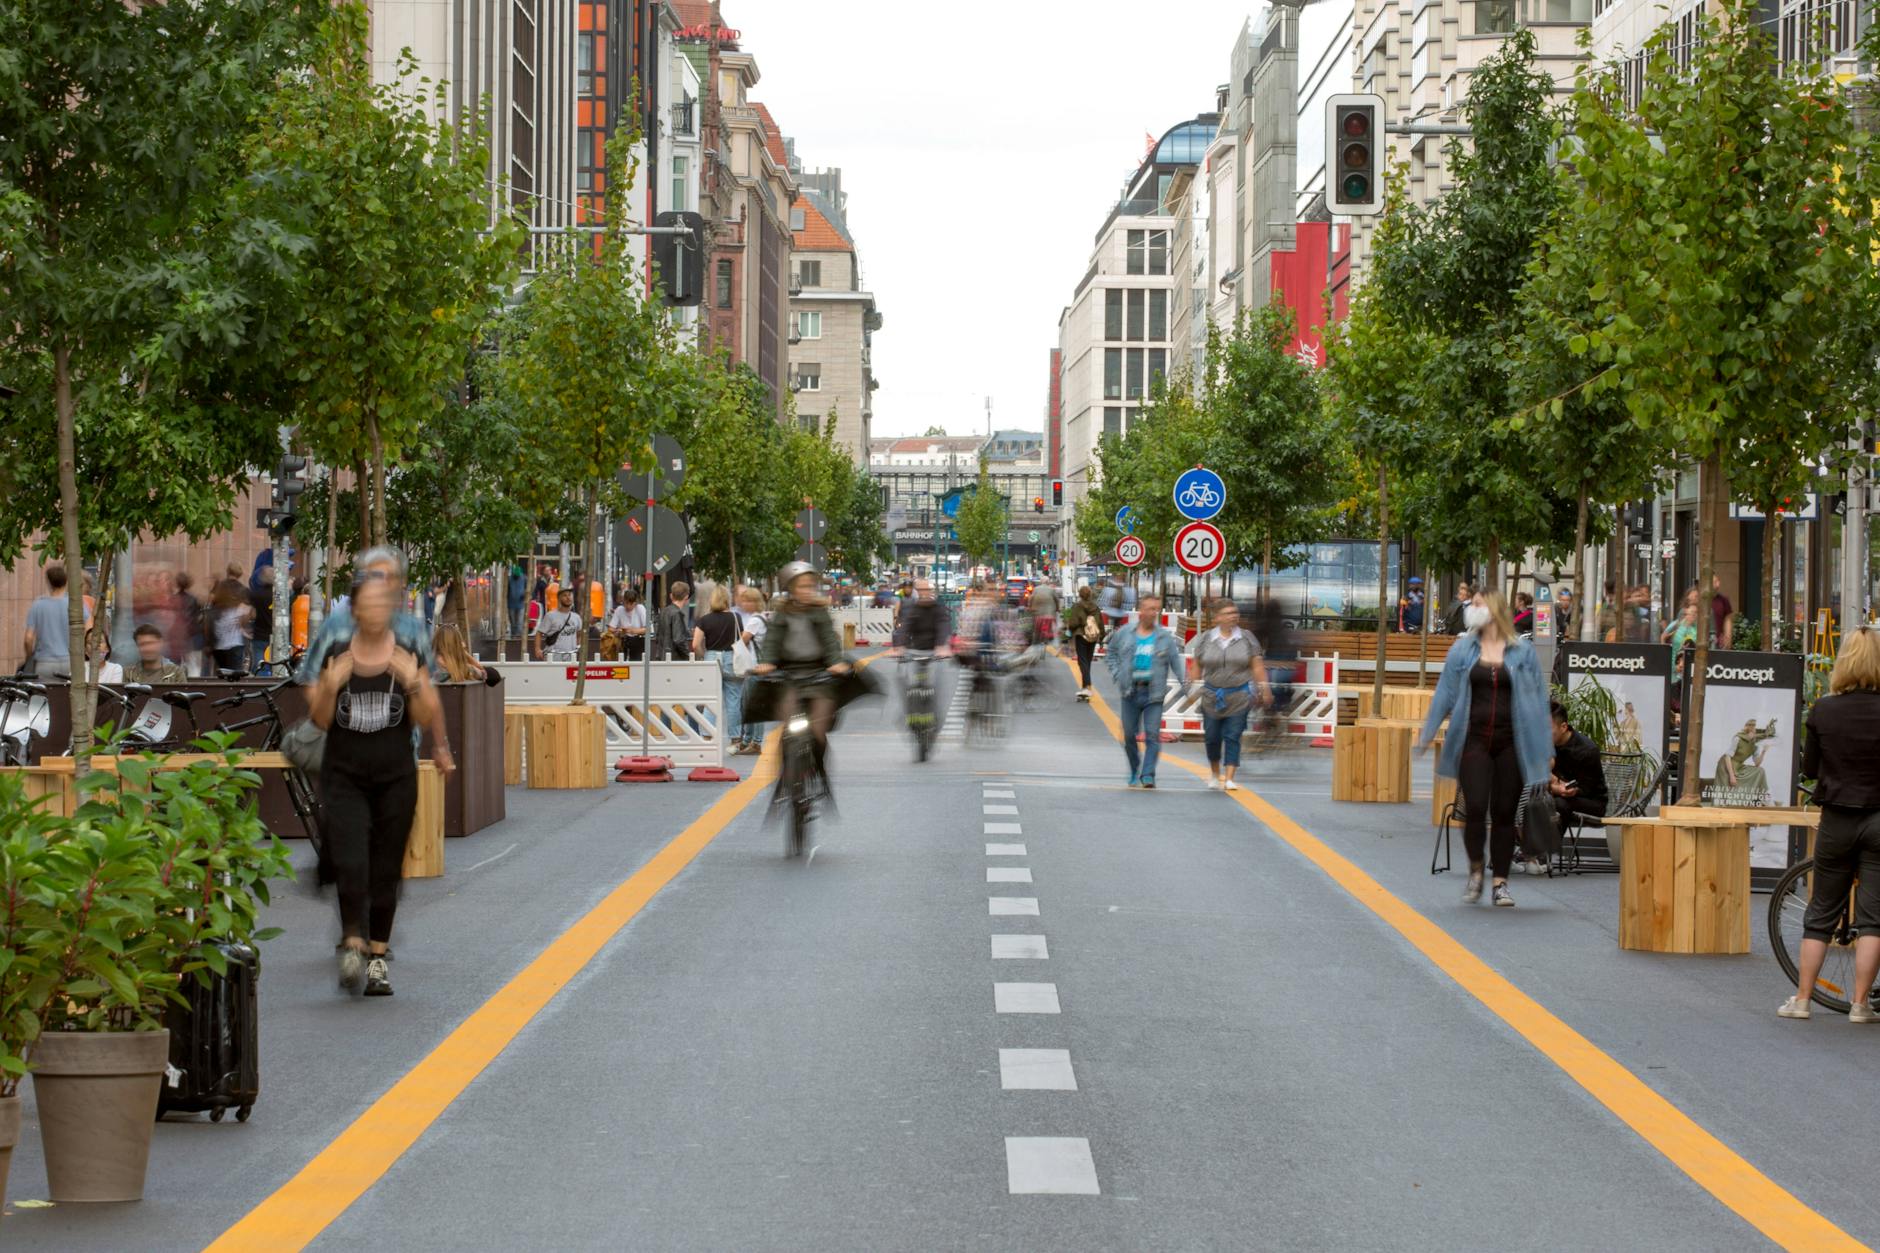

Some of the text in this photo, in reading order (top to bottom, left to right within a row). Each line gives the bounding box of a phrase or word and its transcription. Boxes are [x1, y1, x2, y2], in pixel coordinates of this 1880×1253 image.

[895, 531, 934, 540] BAHNHOF
[1122, 544, 1138, 557] 20
[1186, 537, 1213, 558] 20
[1540, 586, 1550, 600] P
[1568, 653, 1646, 673] BoConcept
[1690, 662, 1775, 684] oConcept
